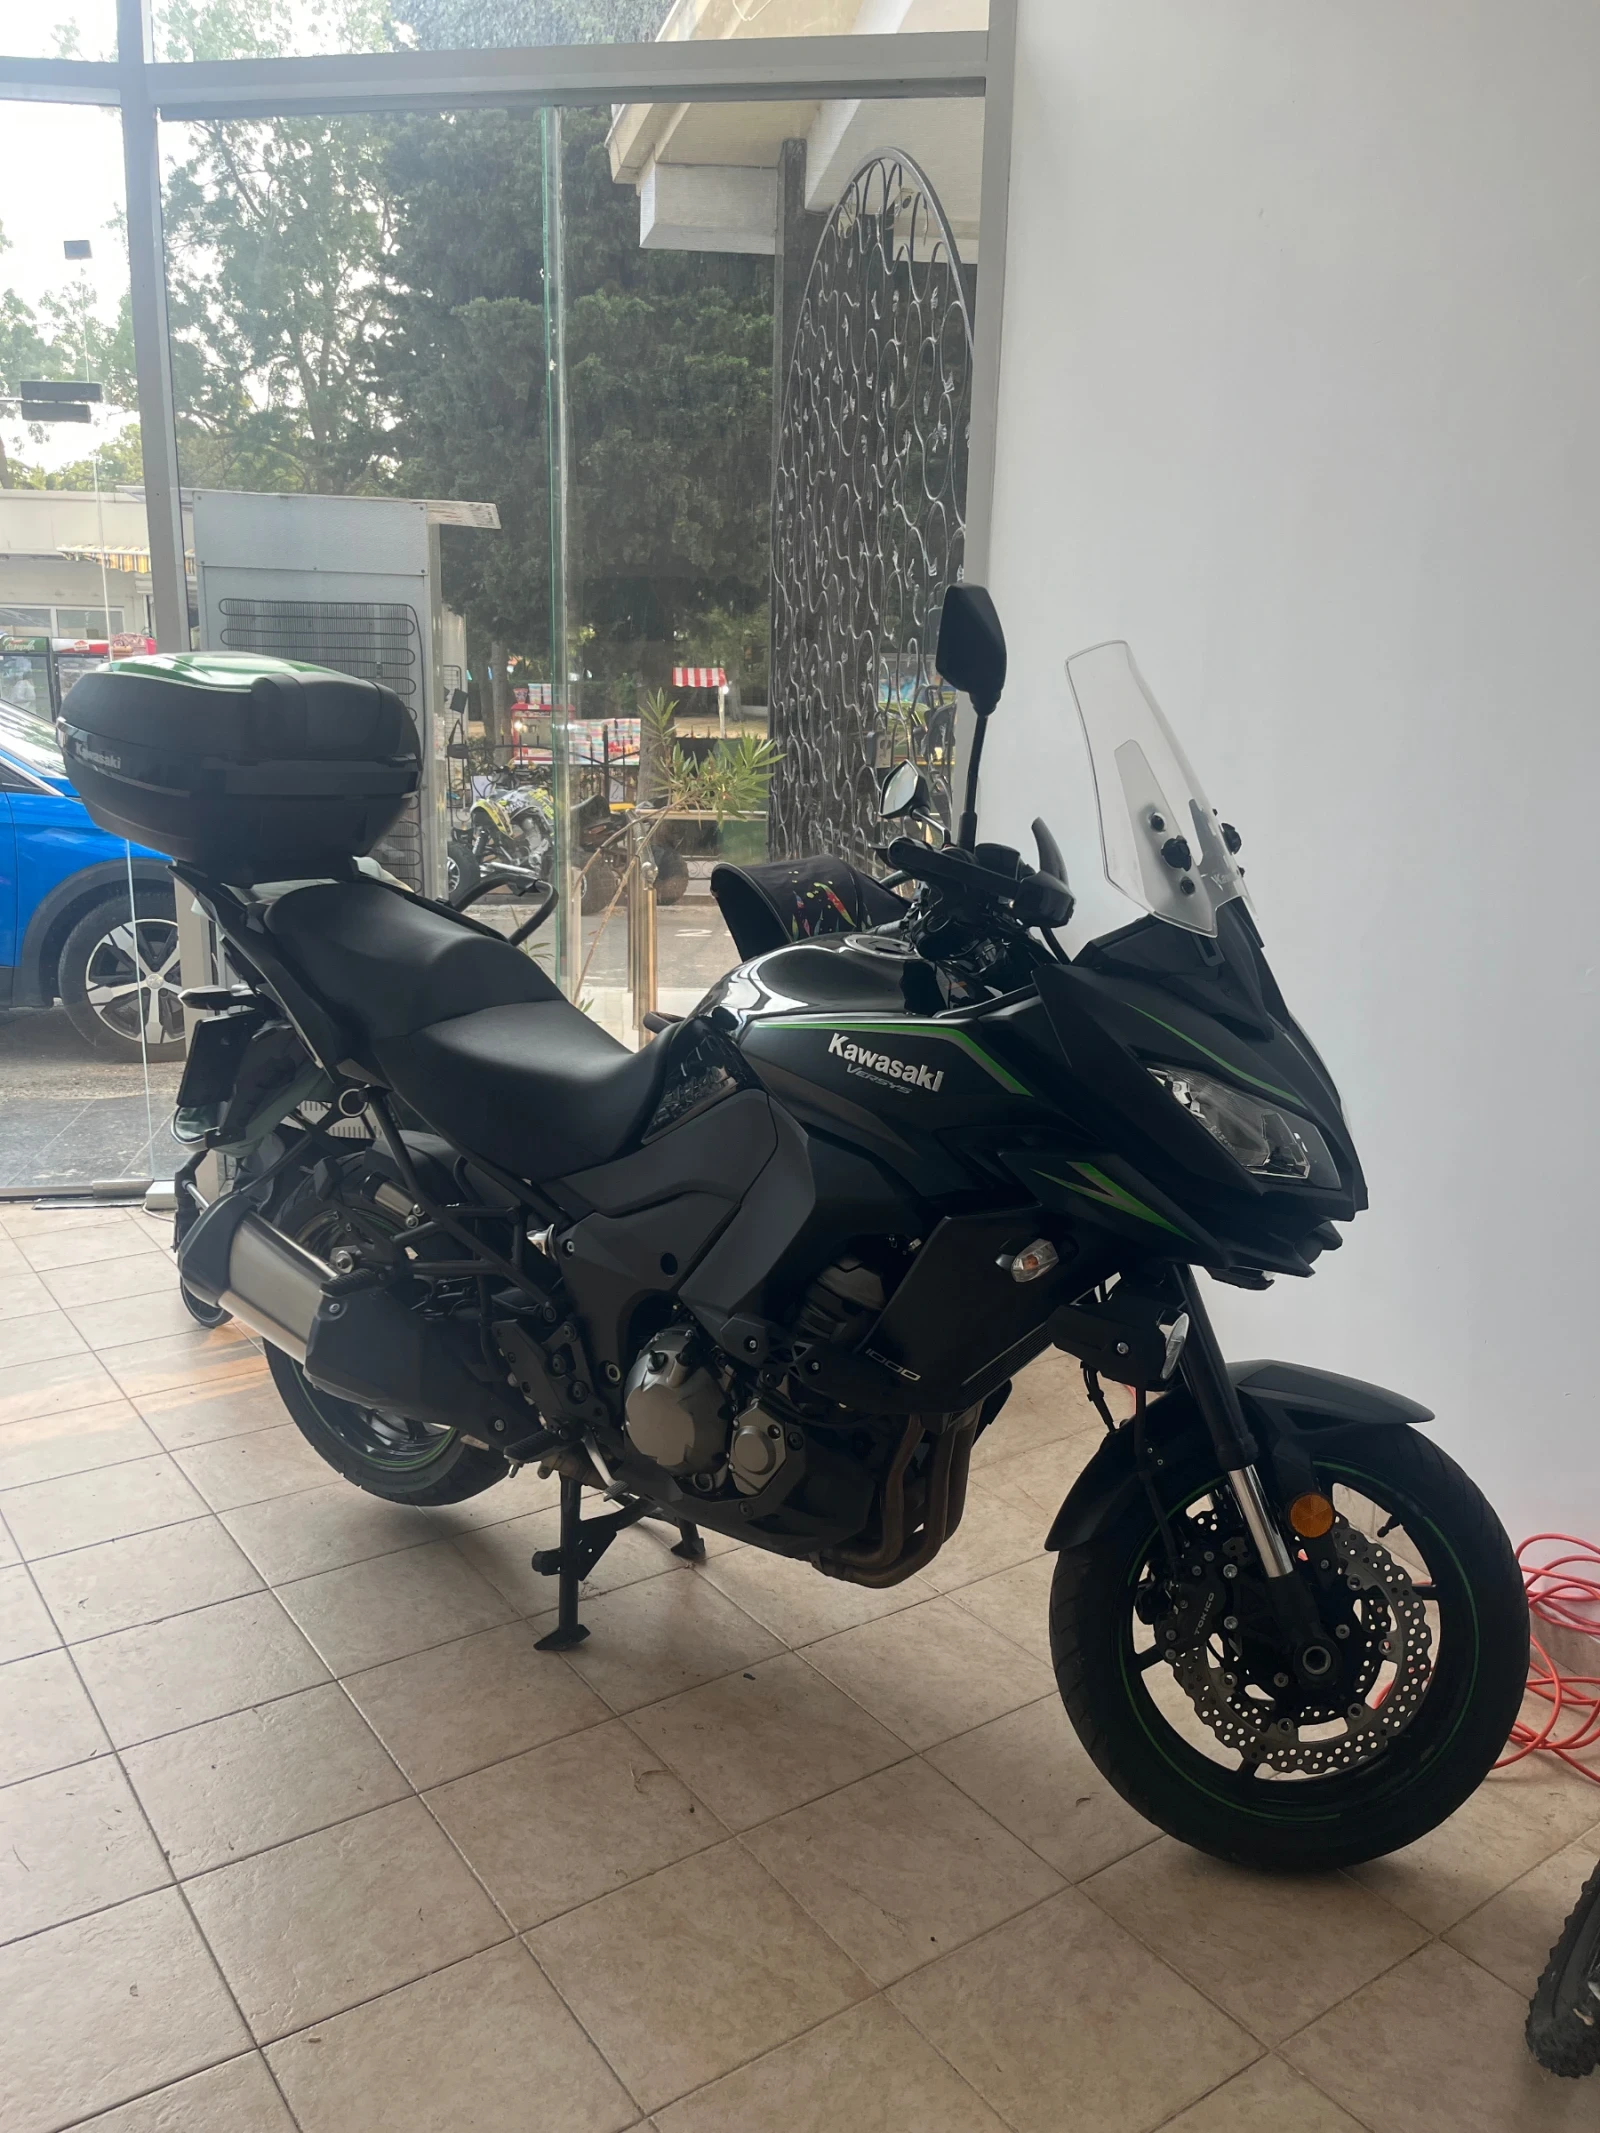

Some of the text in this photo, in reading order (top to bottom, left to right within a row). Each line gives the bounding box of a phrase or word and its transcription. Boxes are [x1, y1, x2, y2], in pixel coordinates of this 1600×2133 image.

[75, 742, 121, 769] Kawasaki
[828, 1032, 944, 1092] Kawasaki
[846, 1063, 912, 1094] VERSYS
[865, 1348, 921, 1381] 1000
[1194, 1592, 1215, 1635] TOKICO
